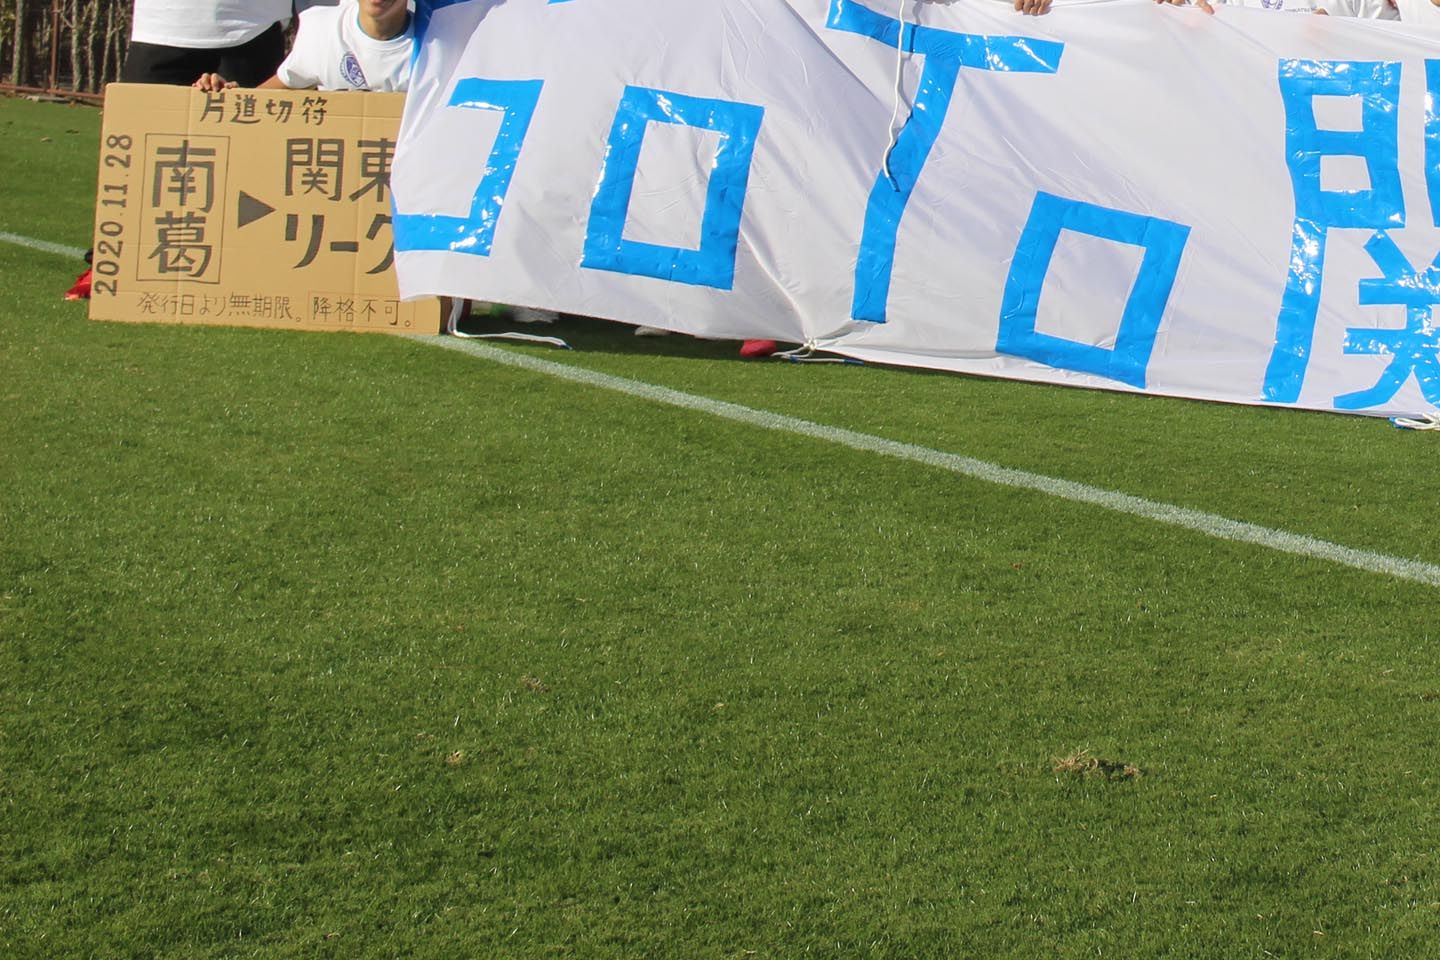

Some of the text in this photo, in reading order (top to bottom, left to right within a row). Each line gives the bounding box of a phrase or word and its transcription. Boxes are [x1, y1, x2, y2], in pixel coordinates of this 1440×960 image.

[200, 92, 328, 126] 片道切符
[94, 134, 133, 297] 2020.11.28
[148, 139, 217, 278] 南葛
[285, 137, 398, 202] 関東
